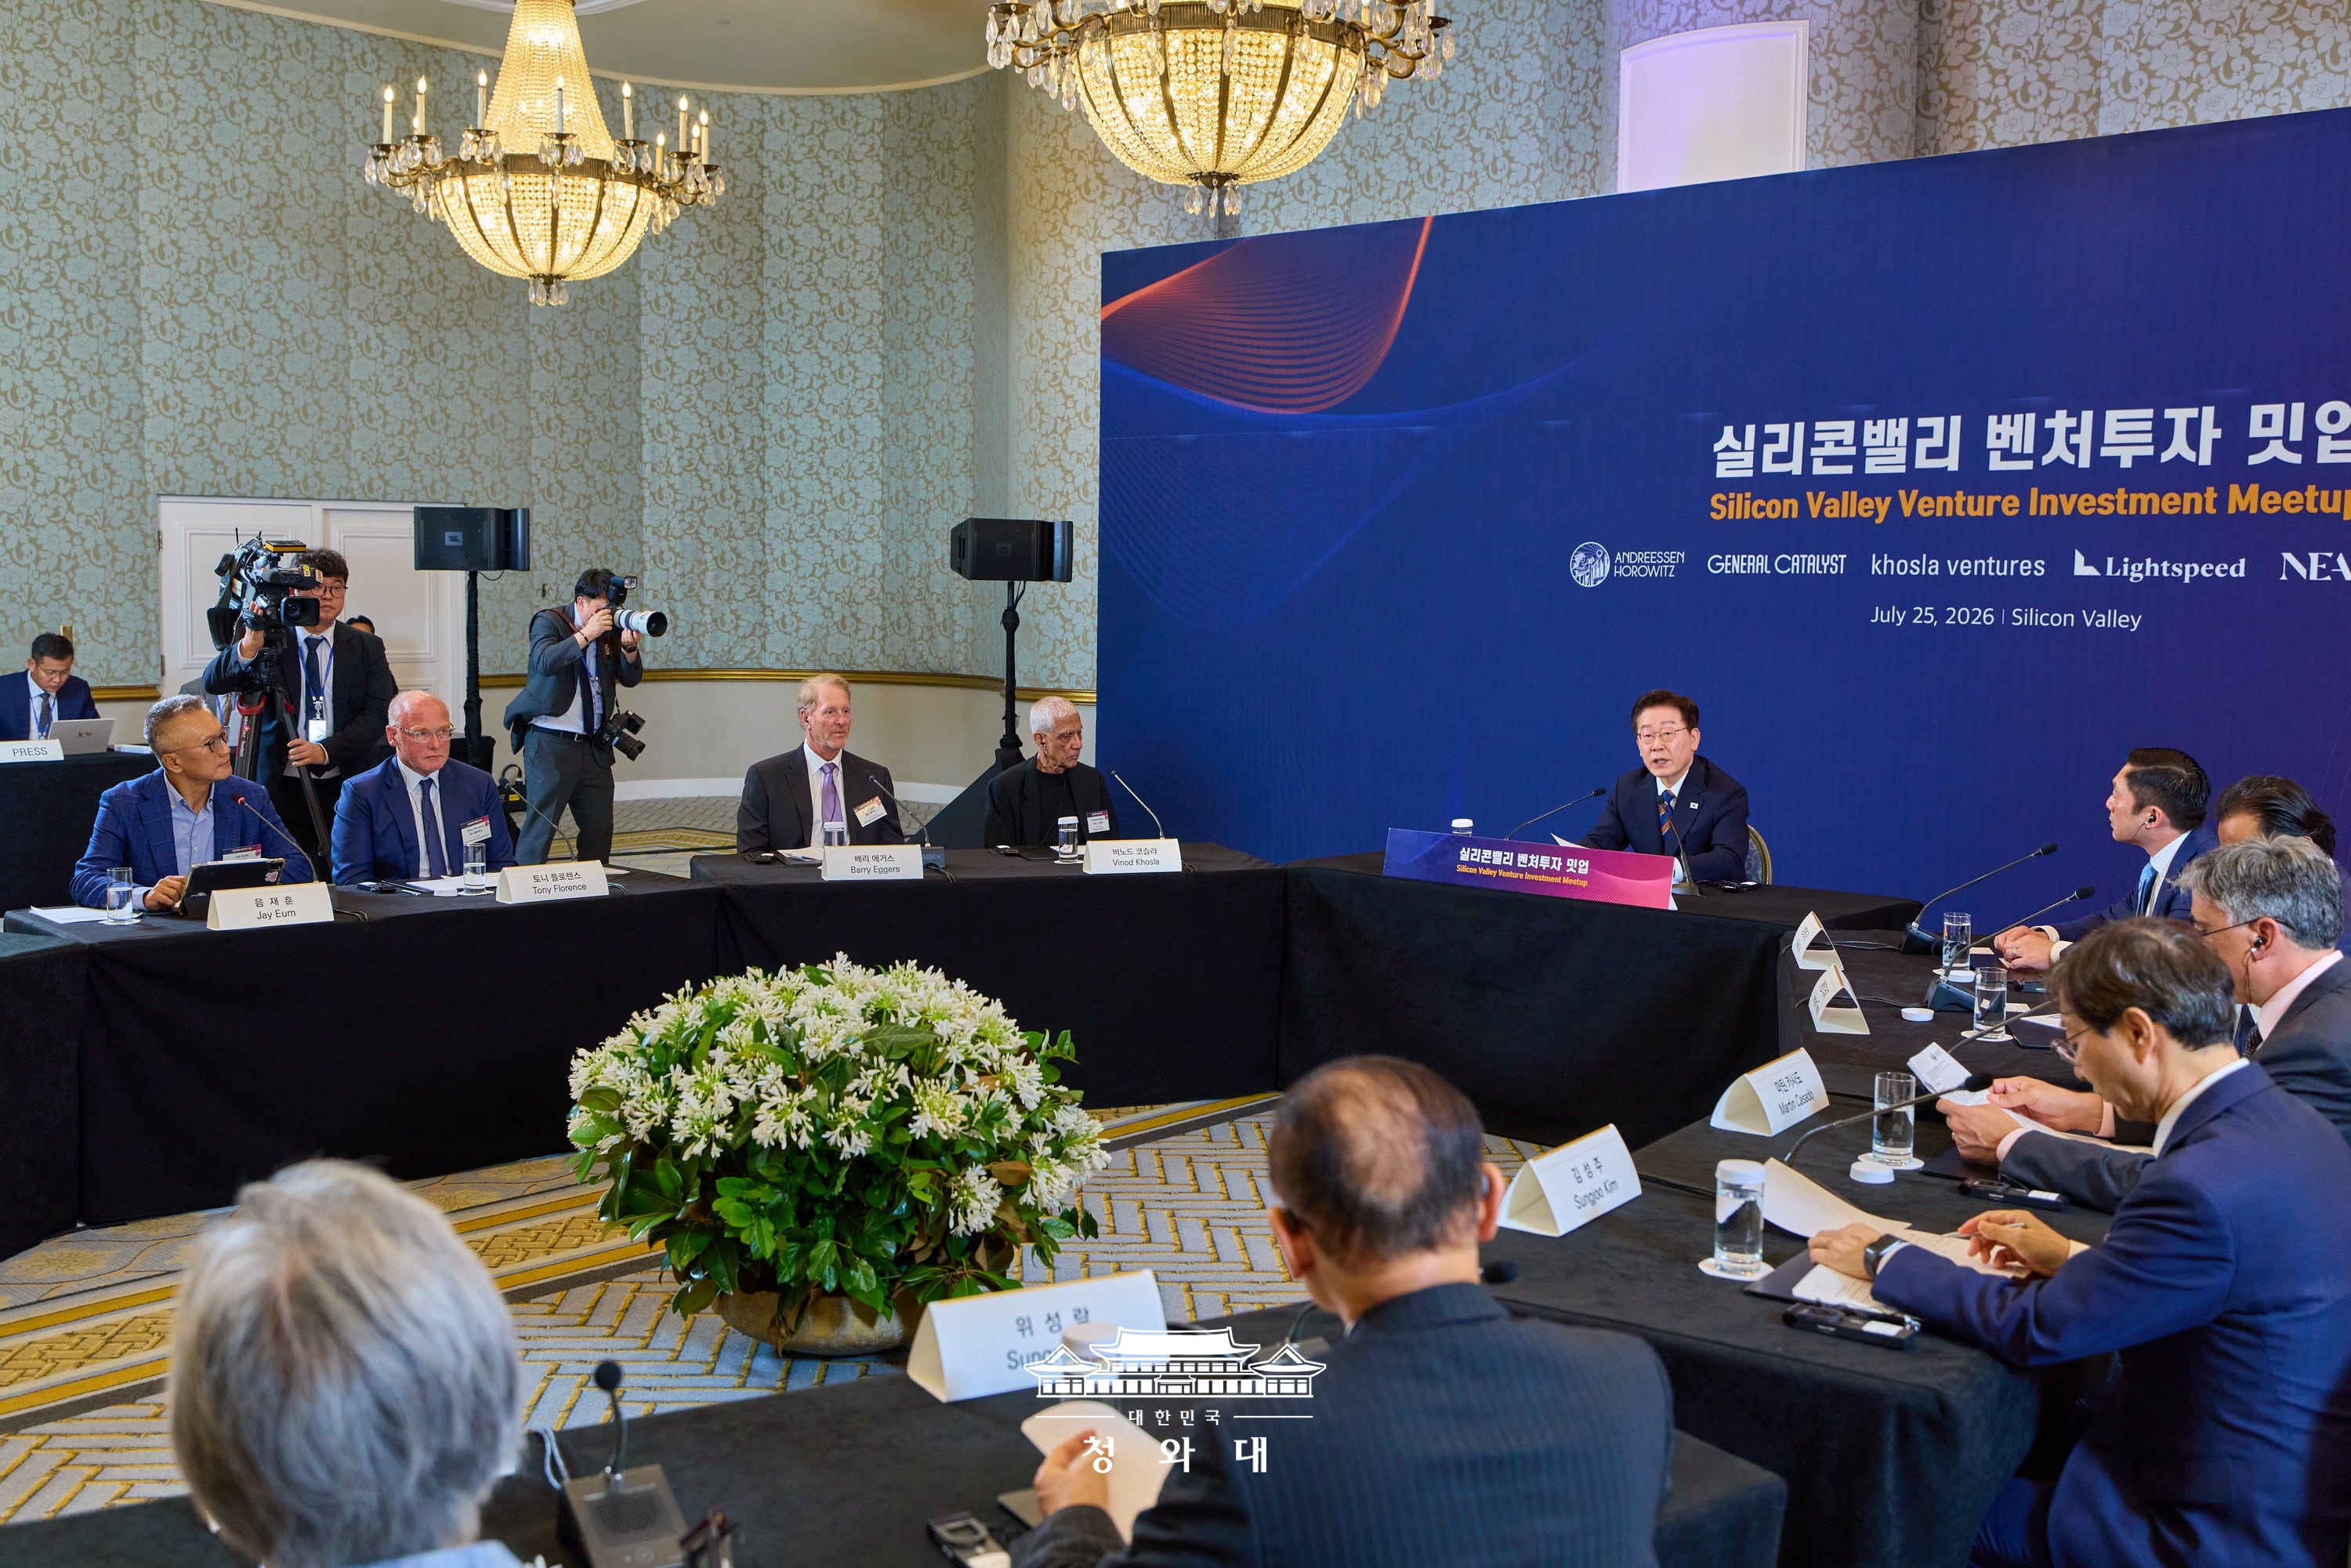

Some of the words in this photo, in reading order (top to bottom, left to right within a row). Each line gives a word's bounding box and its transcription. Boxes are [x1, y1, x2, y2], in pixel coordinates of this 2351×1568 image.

[1713, 415, 1962, 479] 실리콘밸리
[1986, 405, 2222, 471] 벤처투자
[1710, 491, 1799, 521] Silicon
[1806, 490, 1892, 524] Valley
[1898, 488, 2020, 518] Venture
[2029, 485, 2218, 516] Investment
[1614, 551, 1685, 563] ANDREESSEN
[1707, 554, 1771, 574] GENERAL
[1774, 554, 1847, 574] CATALYST
[1871, 553, 1940, 576] khosla
[1947, 555, 2046, 576] ventures
[1614, 564, 1675, 578] HOROWITZ
[2106, 556, 2247, 584] Lightspeed
[1870, 607, 1907, 627] July
[1912, 607, 1938, 627] 25,
[1945, 607, 1994, 625] 2026
[2011, 608, 2075, 627] Silicon
[2081, 609, 2143, 632] Valley
[12, 747, 48, 757] PRESS
[854, 854, 869, 863] 배리
[1459, 846, 1513, 866] 실리콘밸리
[1517, 853, 1562, 871] 벤처투자
[1566, 857, 1589, 875] 밋업
[533, 873, 549, 883] 토니
[551, 871, 582, 882] 플로렌스
[851, 866, 871, 875] Barry
[873, 865, 900, 875] Eggers
[1456, 864, 1477, 875] Silicon
[1478, 867, 1498, 878] Valley
[1498, 869, 1523, 879] Venture
[1524, 872, 1561, 884] Investment
[1563, 877, 1588, 888] Meetup
[532, 885, 552, 896] Tony
[553, 883, 588, 893] Florence
[256, 911, 273, 921] Jay
[275, 909, 296, 918] Eum
[1778, 1098, 1796, 1116] Martin
[1795, 1089, 1815, 1106] Casado
[1574, 1187, 1604, 1210] Sungjoo
[1603, 1179, 1620, 1196] Kim
